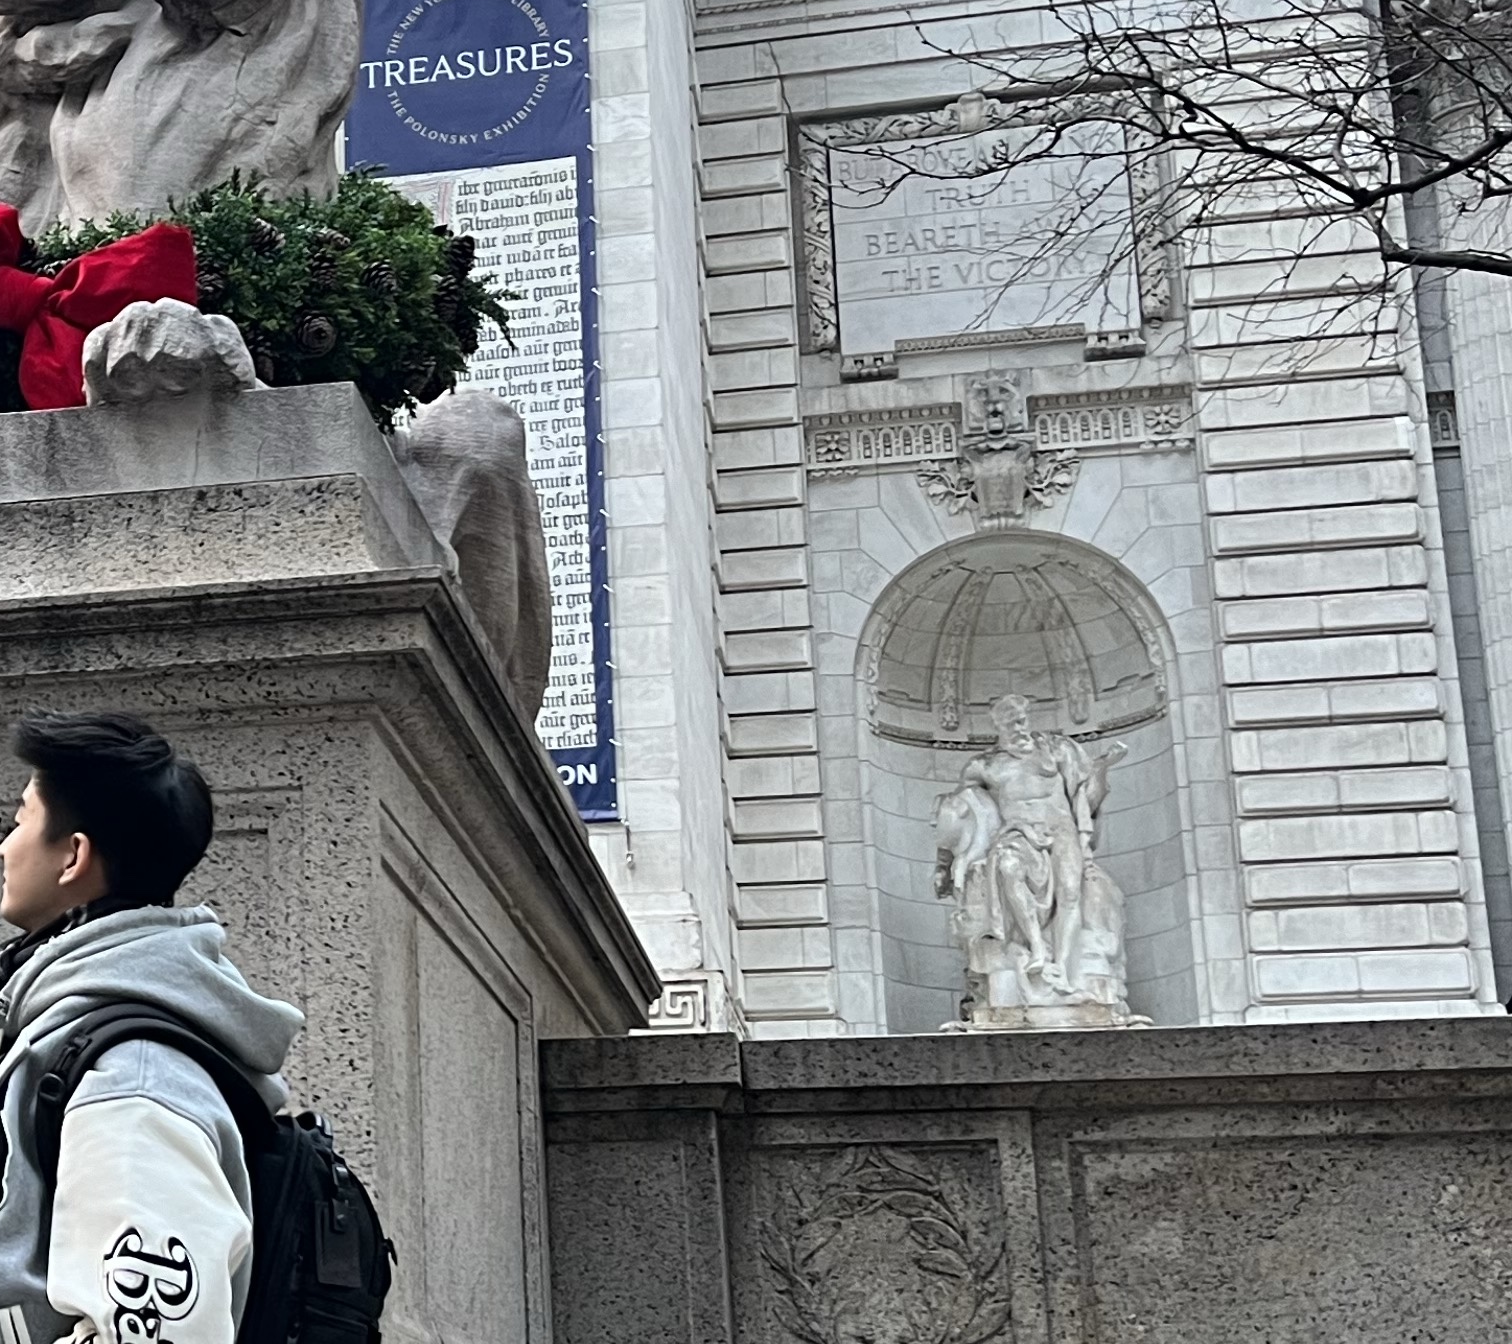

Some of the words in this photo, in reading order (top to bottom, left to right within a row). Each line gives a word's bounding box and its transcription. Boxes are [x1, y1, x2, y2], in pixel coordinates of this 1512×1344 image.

[386, 32, 404, 55] THE
[399, 4, 424, 31] NEW
[359, 39, 573, 89] TREASURES
[387, 90, 407, 117] THE
[404, 116, 478, 145] POLONSKY
[484, 73, 550, 140] EXHIBITION
[925, 179, 1030, 210] TRUTH
[864, 222, 1002, 256] BEARETH
[882, 265, 940, 292] THE
